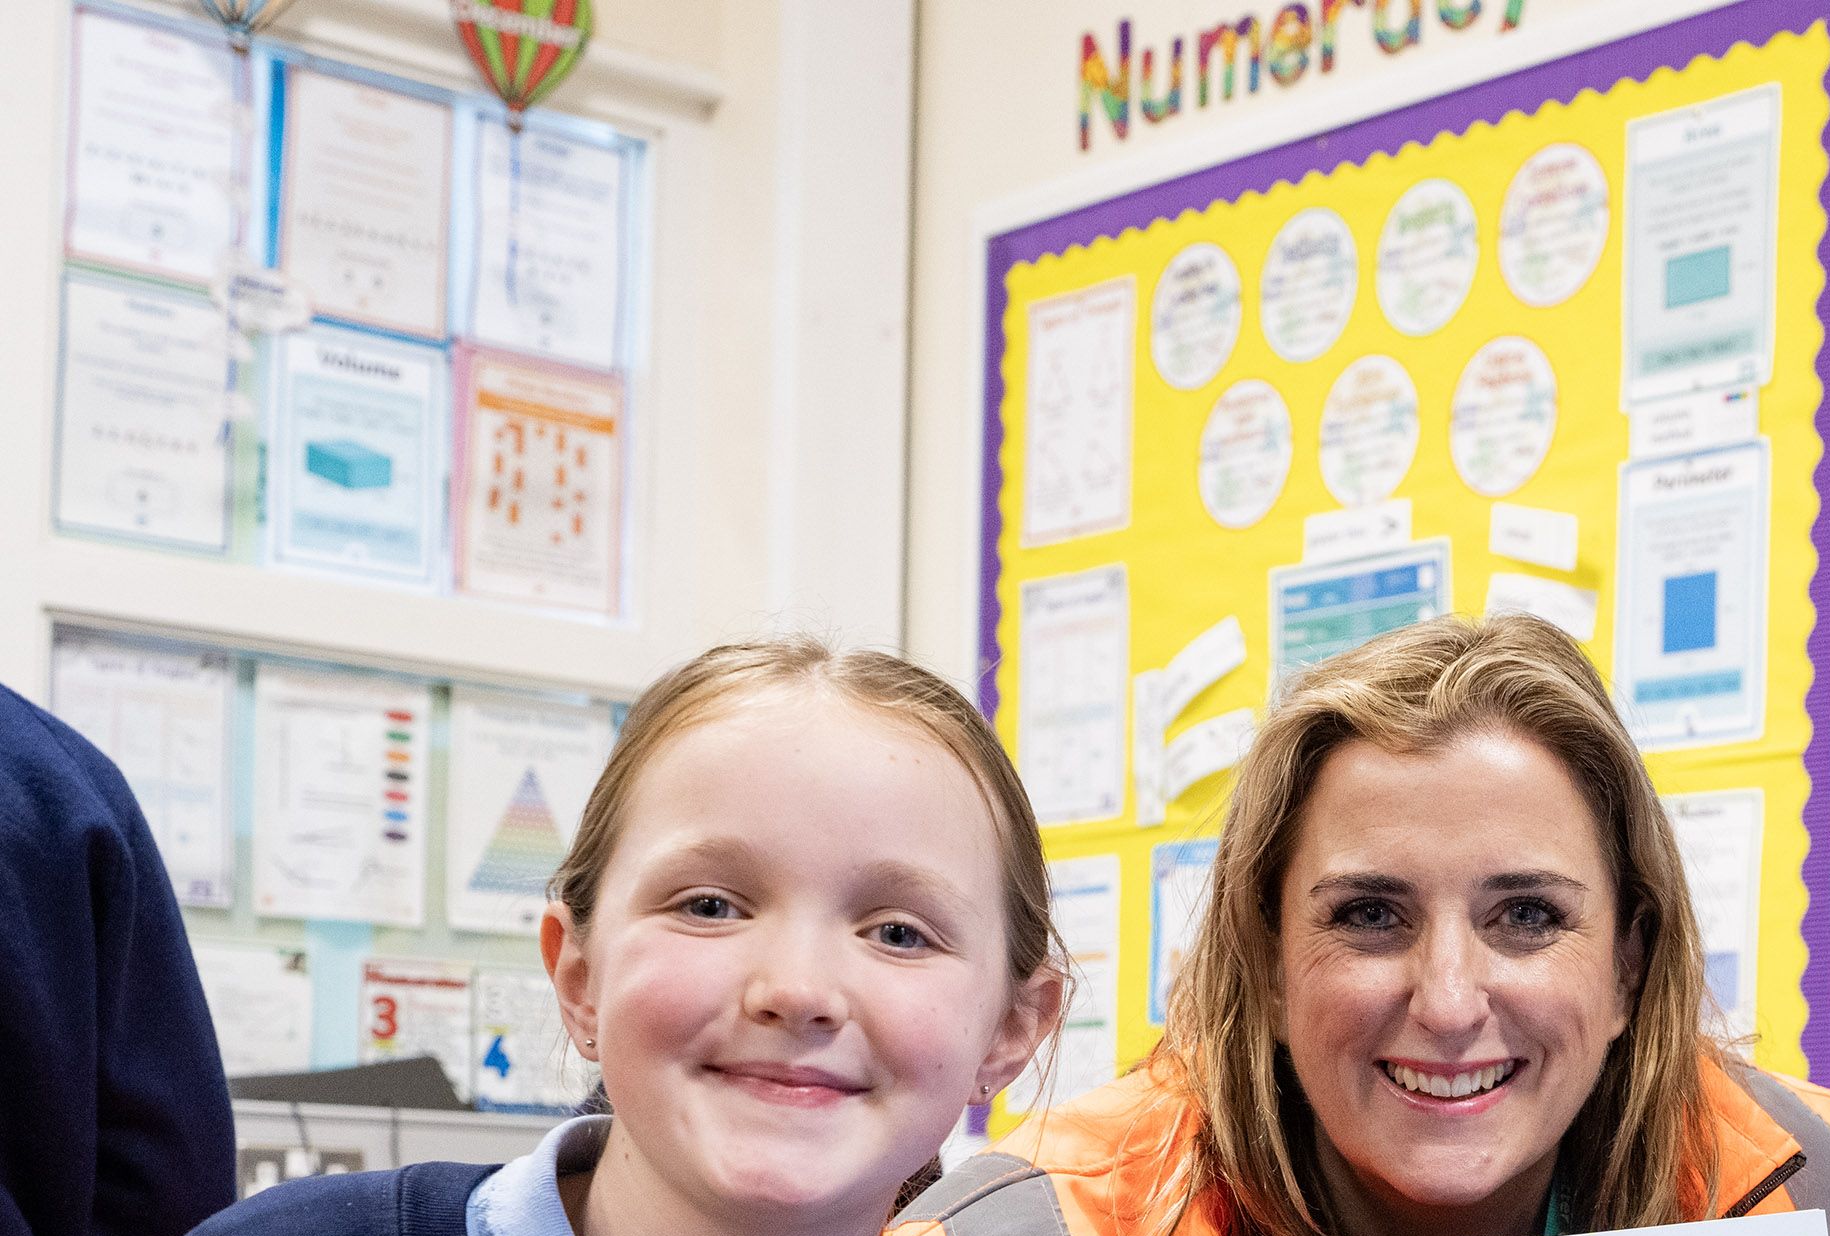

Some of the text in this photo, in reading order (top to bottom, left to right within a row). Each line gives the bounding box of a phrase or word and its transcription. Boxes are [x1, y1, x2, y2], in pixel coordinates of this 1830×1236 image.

[1078, 0, 1525, 151] Numera
[372, 995, 398, 1040] 3
[483, 1035, 511, 1079] 4
